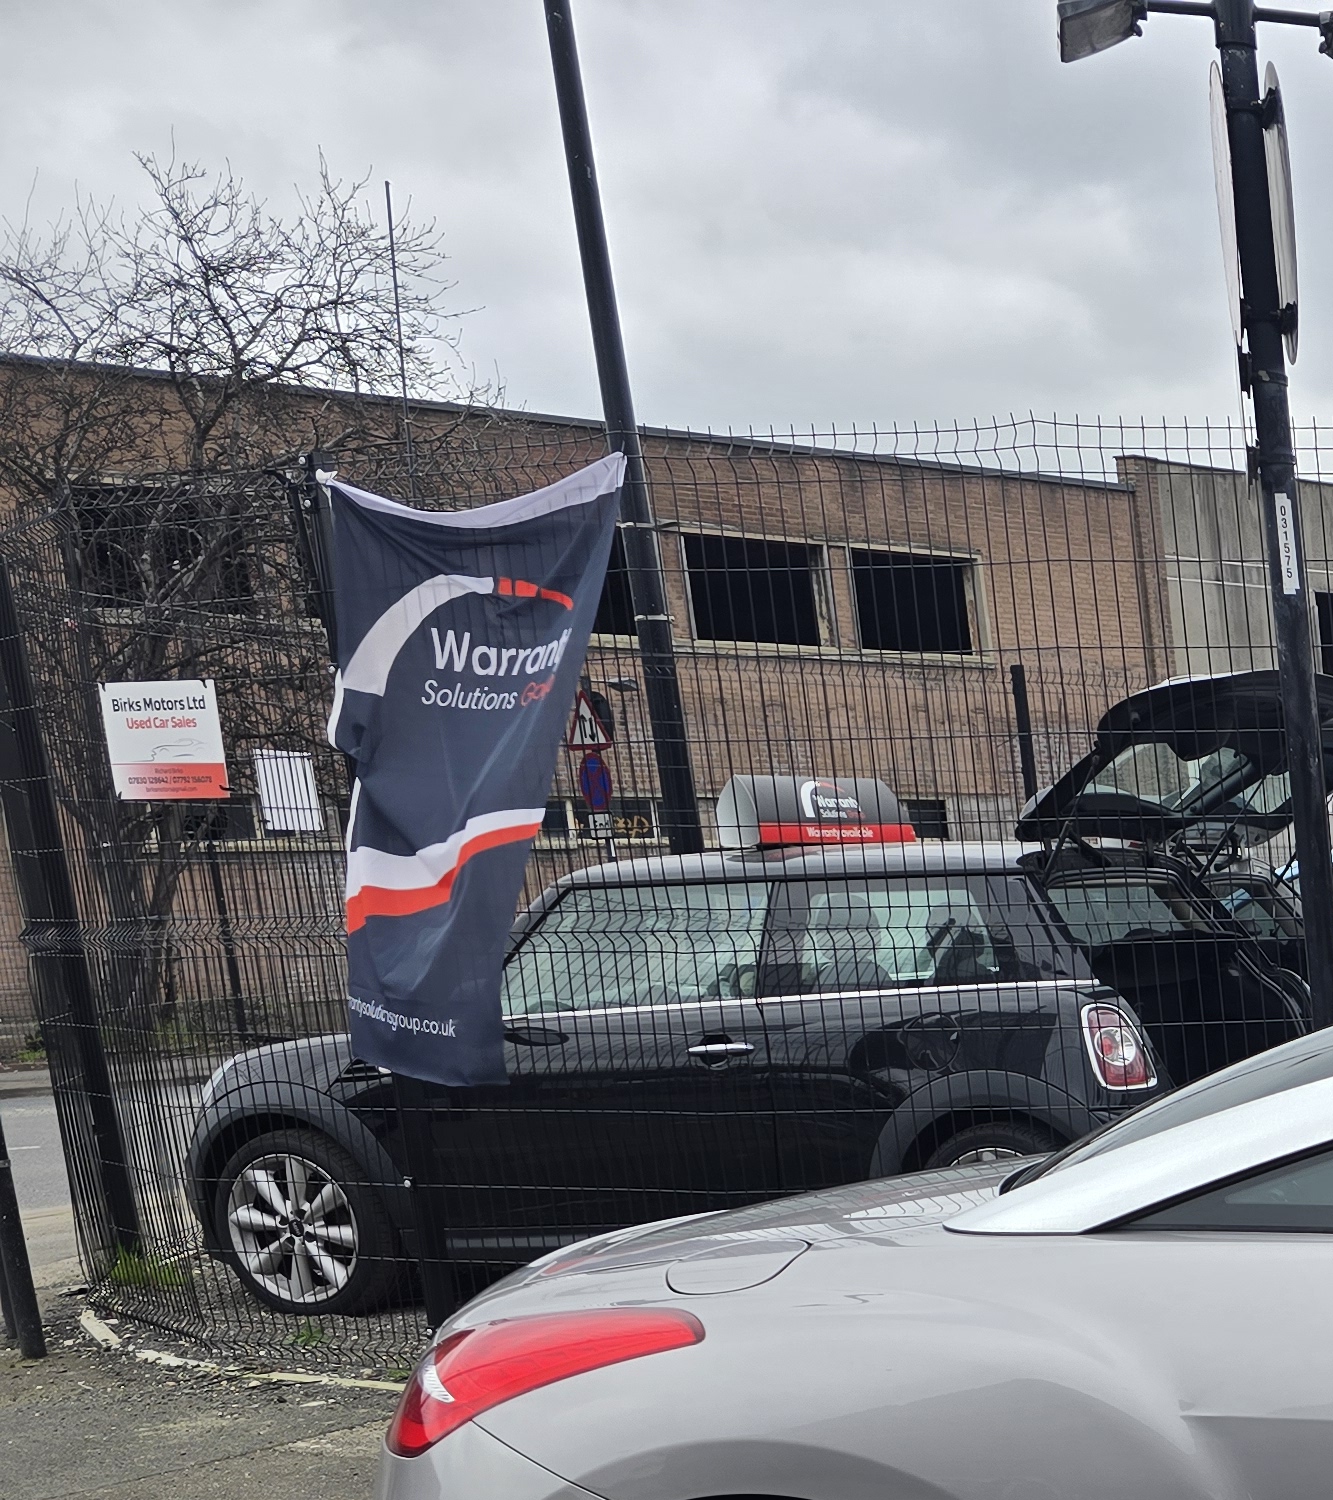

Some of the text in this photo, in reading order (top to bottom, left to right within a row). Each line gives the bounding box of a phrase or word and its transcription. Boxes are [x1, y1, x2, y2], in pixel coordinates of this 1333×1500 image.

[1280, 505, 1293, 578] 031575
[111, 695, 206, 712] Birks Motors Ltd
[421, 679, 518, 711] Solutions
[126, 716, 197, 729] Used Car Sales
